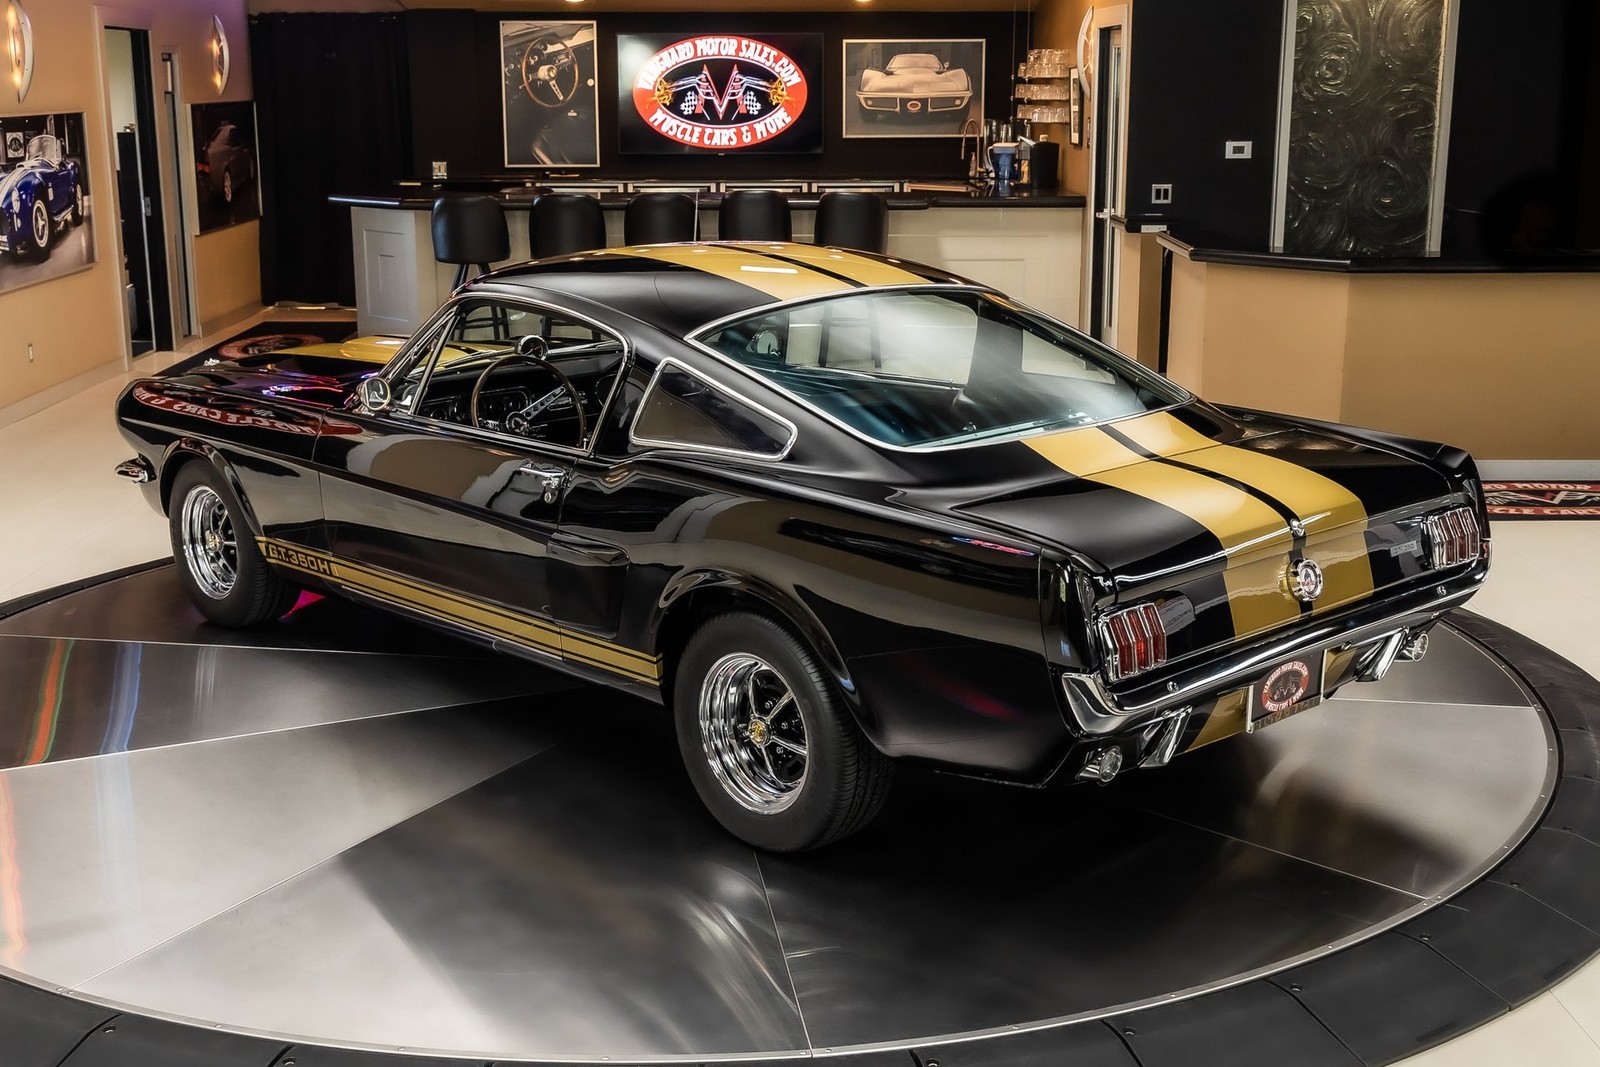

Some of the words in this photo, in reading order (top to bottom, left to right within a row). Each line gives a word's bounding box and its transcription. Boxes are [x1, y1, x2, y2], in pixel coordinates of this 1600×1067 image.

[695, 38, 738, 57] MOTOR
[739, 40, 801, 87] SALES.COM
[649, 108, 702, 143] MUSCLE
[703, 128, 737, 146] CARS
[741, 126, 752, 143] &
[753, 107, 792, 139] MORE
[1512, 482, 1592, 491] MOTOR
